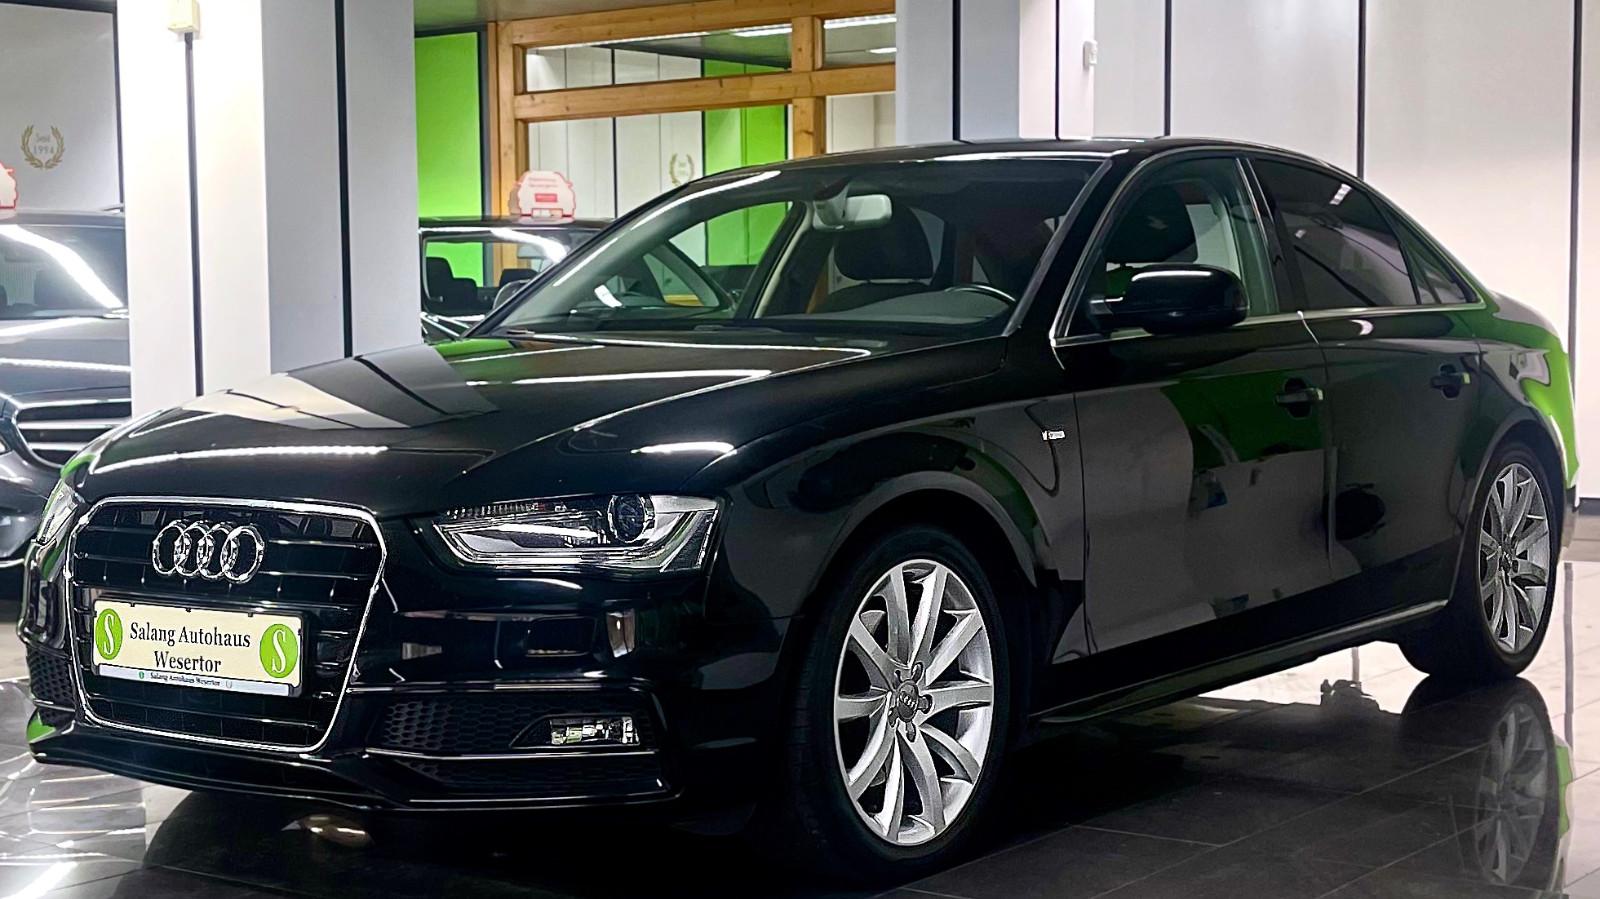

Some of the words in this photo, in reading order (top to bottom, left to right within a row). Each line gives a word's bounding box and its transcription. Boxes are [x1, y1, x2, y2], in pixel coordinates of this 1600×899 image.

[34, 145, 54, 154] 1994
[130, 622, 175, 646] Salang
[179, 626, 251, 647] Autohaus
[154, 651, 221, 672] Wesertor
[150, 673, 168, 681] Salang
